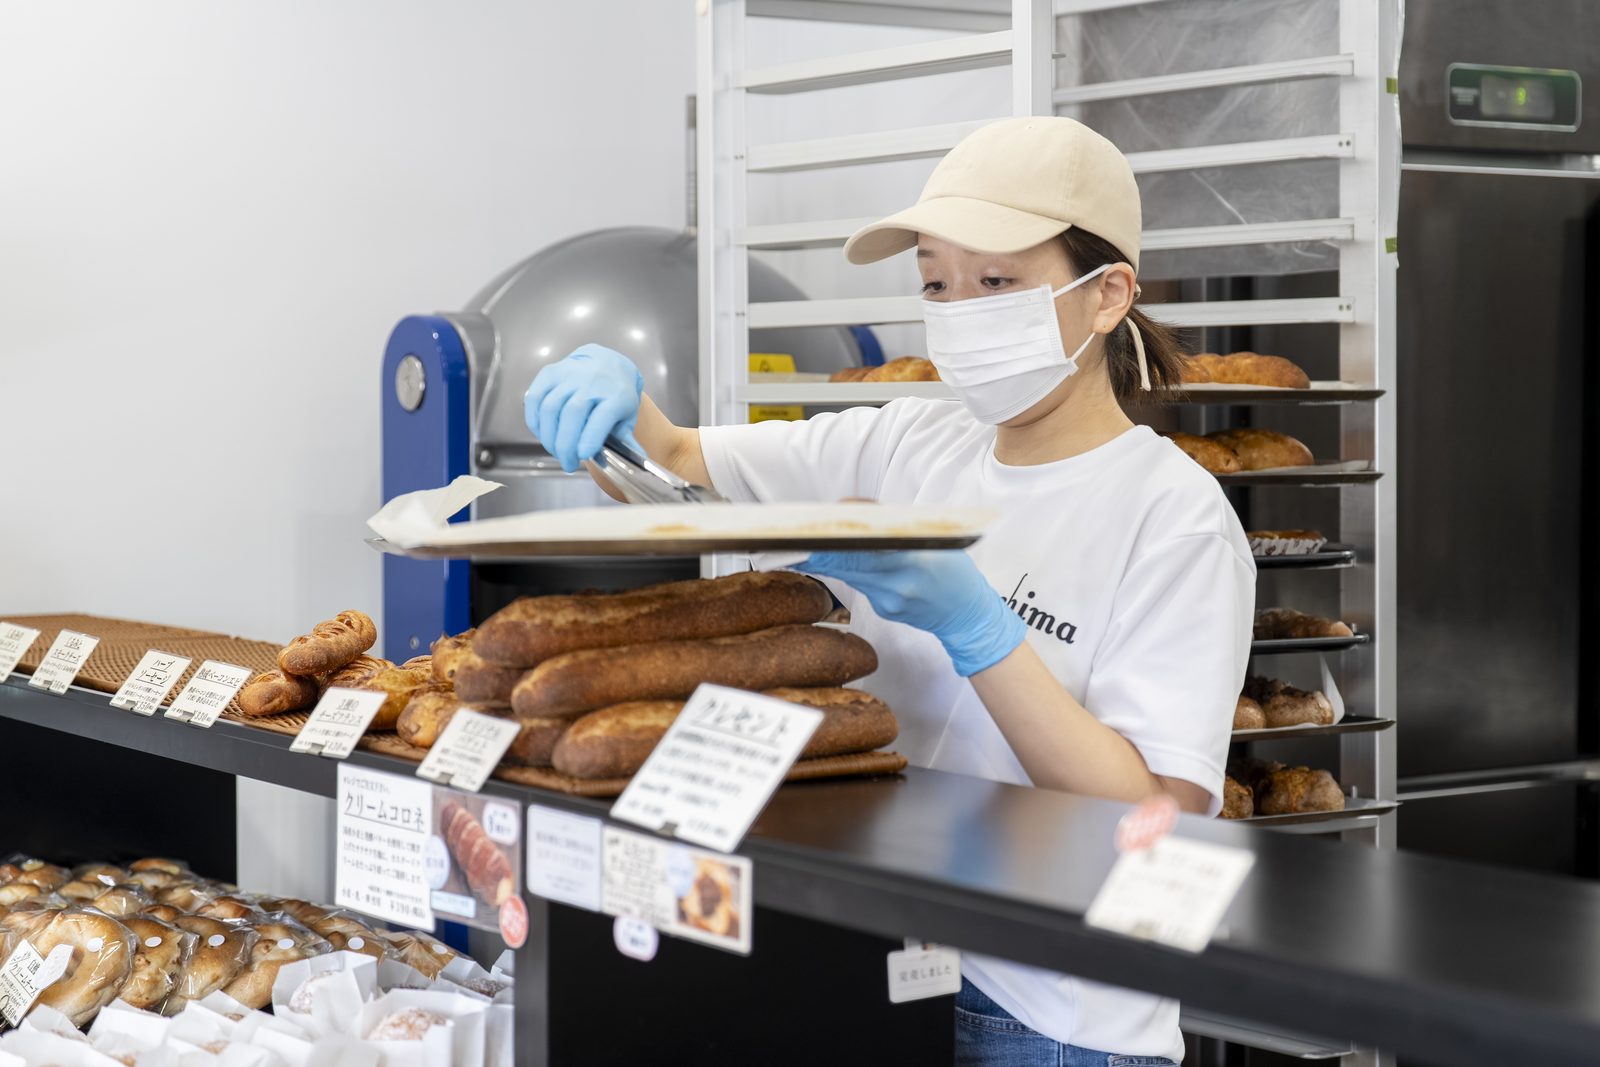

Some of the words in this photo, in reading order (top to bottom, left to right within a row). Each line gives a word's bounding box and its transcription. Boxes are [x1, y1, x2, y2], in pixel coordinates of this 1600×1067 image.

[1001, 573, 1078, 644] hima
[139, 669, 171, 684] ソーセージ
[152, 659, 175, 669] ハーブ
[699, 695, 789, 742] クレセント
[345, 791, 424, 832] クリームコロネ
[10, 963, 40, 997] クリームチーズ
